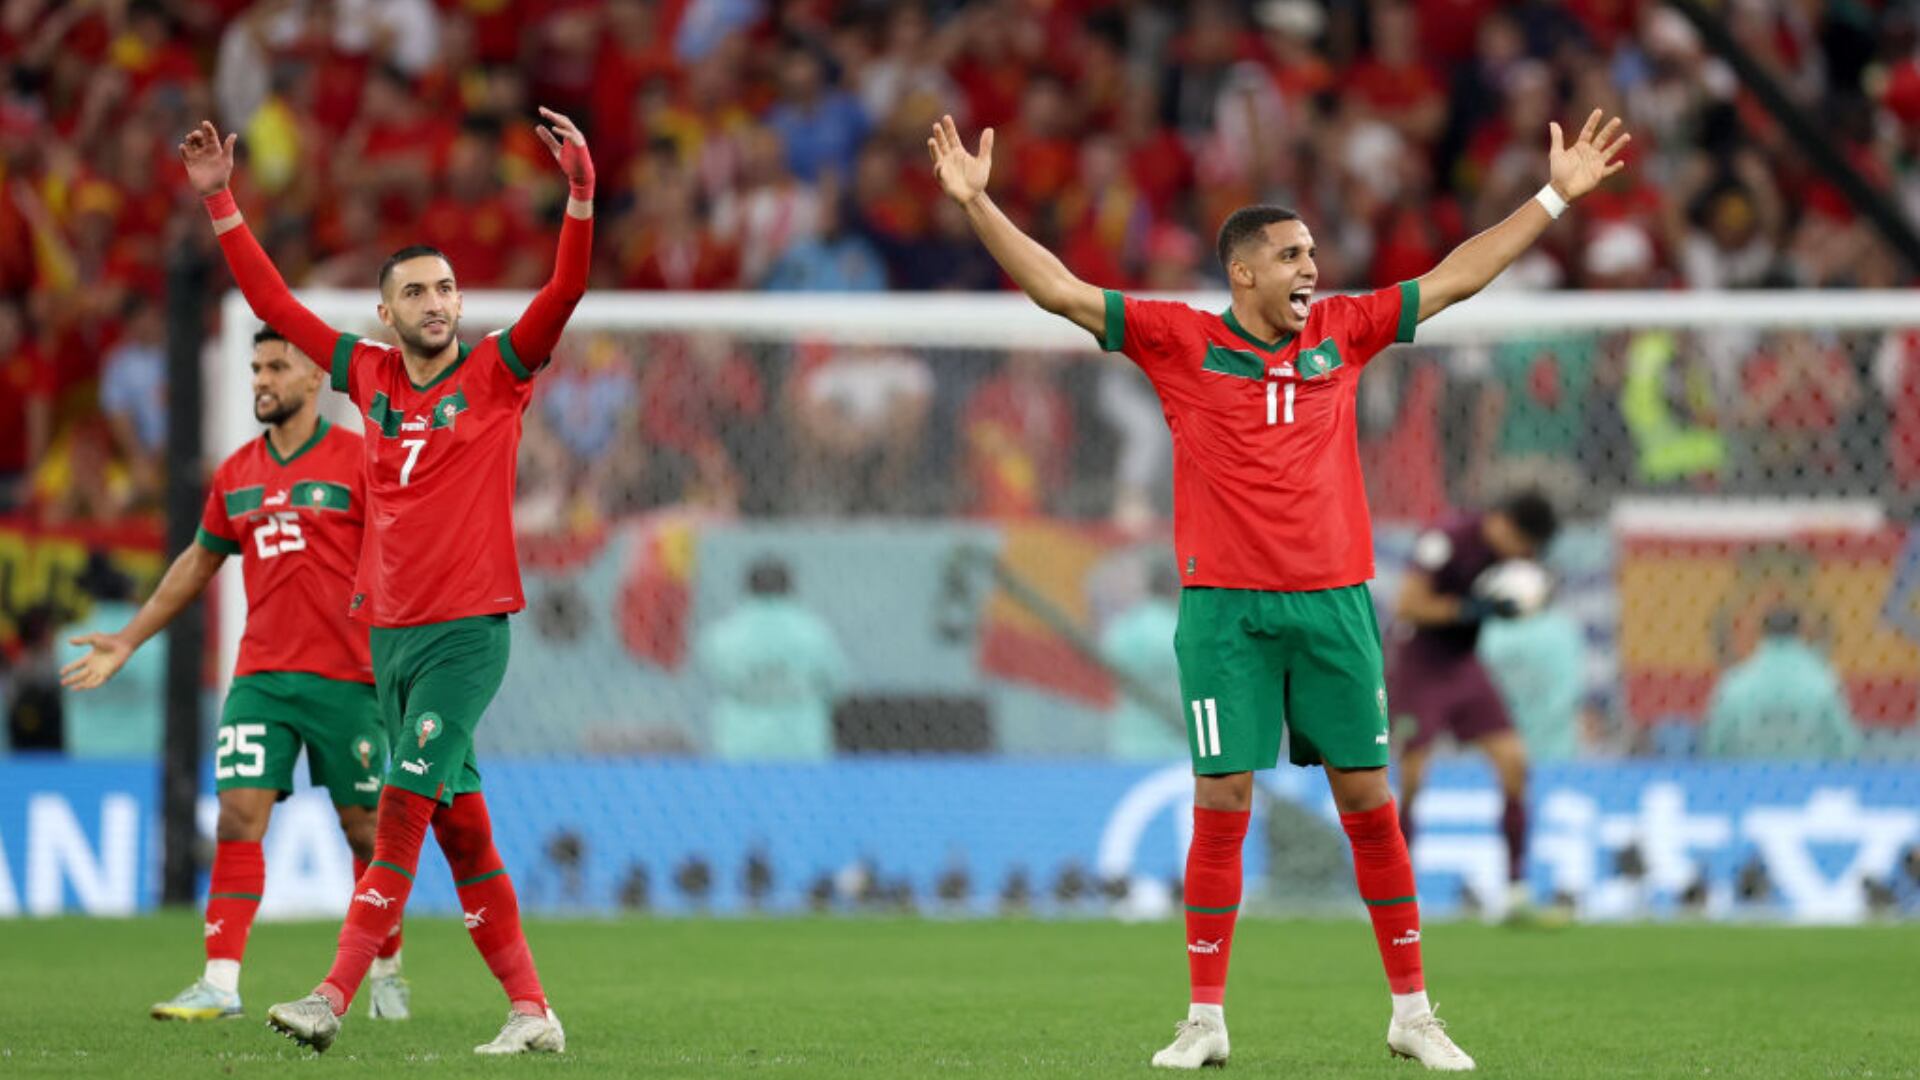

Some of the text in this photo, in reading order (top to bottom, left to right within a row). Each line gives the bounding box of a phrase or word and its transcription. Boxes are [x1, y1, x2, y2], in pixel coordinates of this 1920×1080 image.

[1266, 382, 1295, 425] 11
[400, 439, 427, 487] 7
[254, 511, 307, 559] 25
[216, 723, 267, 779] 25
[1191, 698, 1221, 758] 11
